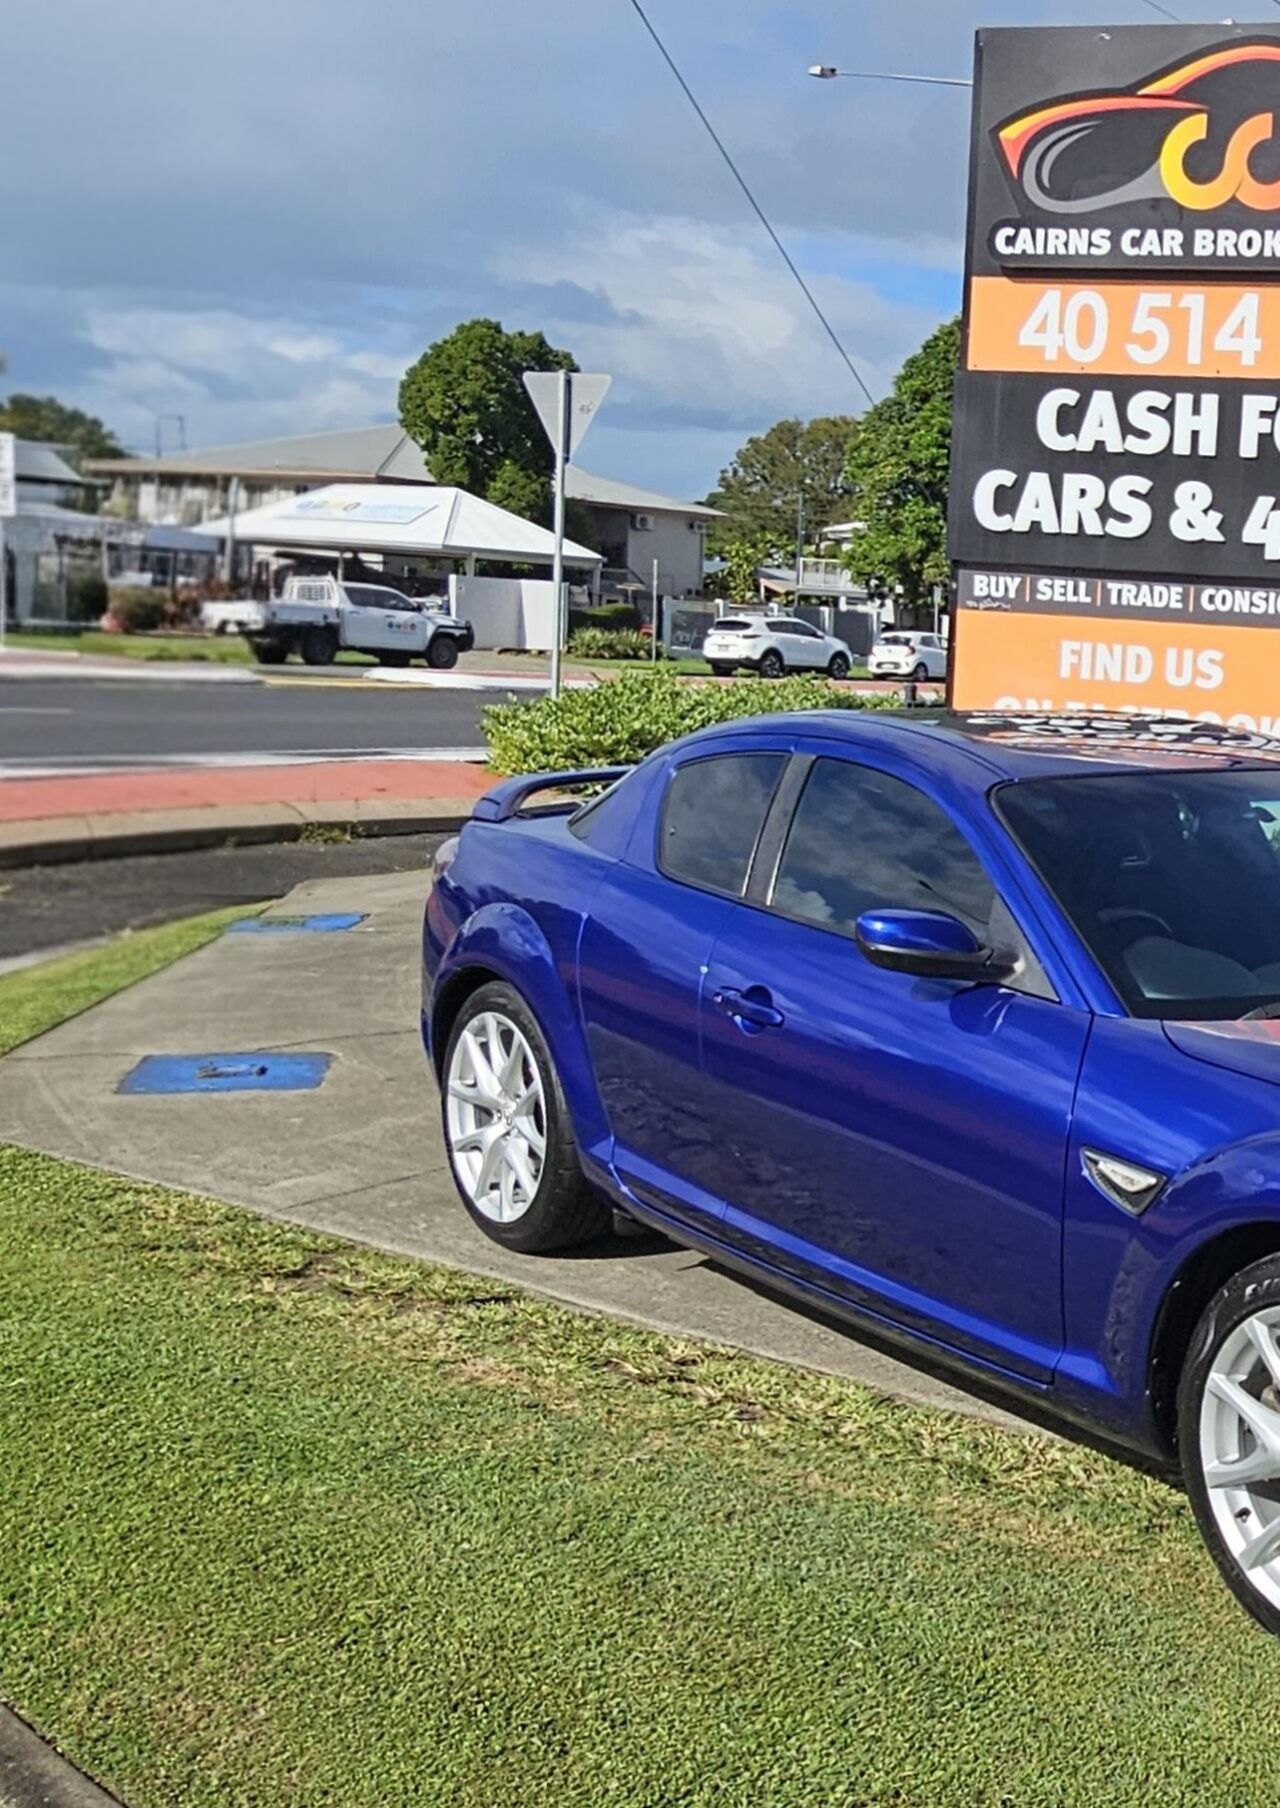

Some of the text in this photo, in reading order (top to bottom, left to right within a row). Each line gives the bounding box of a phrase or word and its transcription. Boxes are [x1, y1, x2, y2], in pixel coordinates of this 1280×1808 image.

[994, 226, 1111, 256] CAIRNS
[1120, 228, 1185, 258] CAR
[1018, 289, 1109, 363] 40
[1124, 291, 1263, 366] 514
[1036, 388, 1219, 458] CASH
[972, 469, 1154, 539] CARS
[1169, 481, 1225, 543] &
[973, 575, 1022, 599] BUY
[1036, 579, 1092, 604] SELL
[1107, 582, 1183, 610] TRADE
[1059, 640, 1225, 690] FIND US
